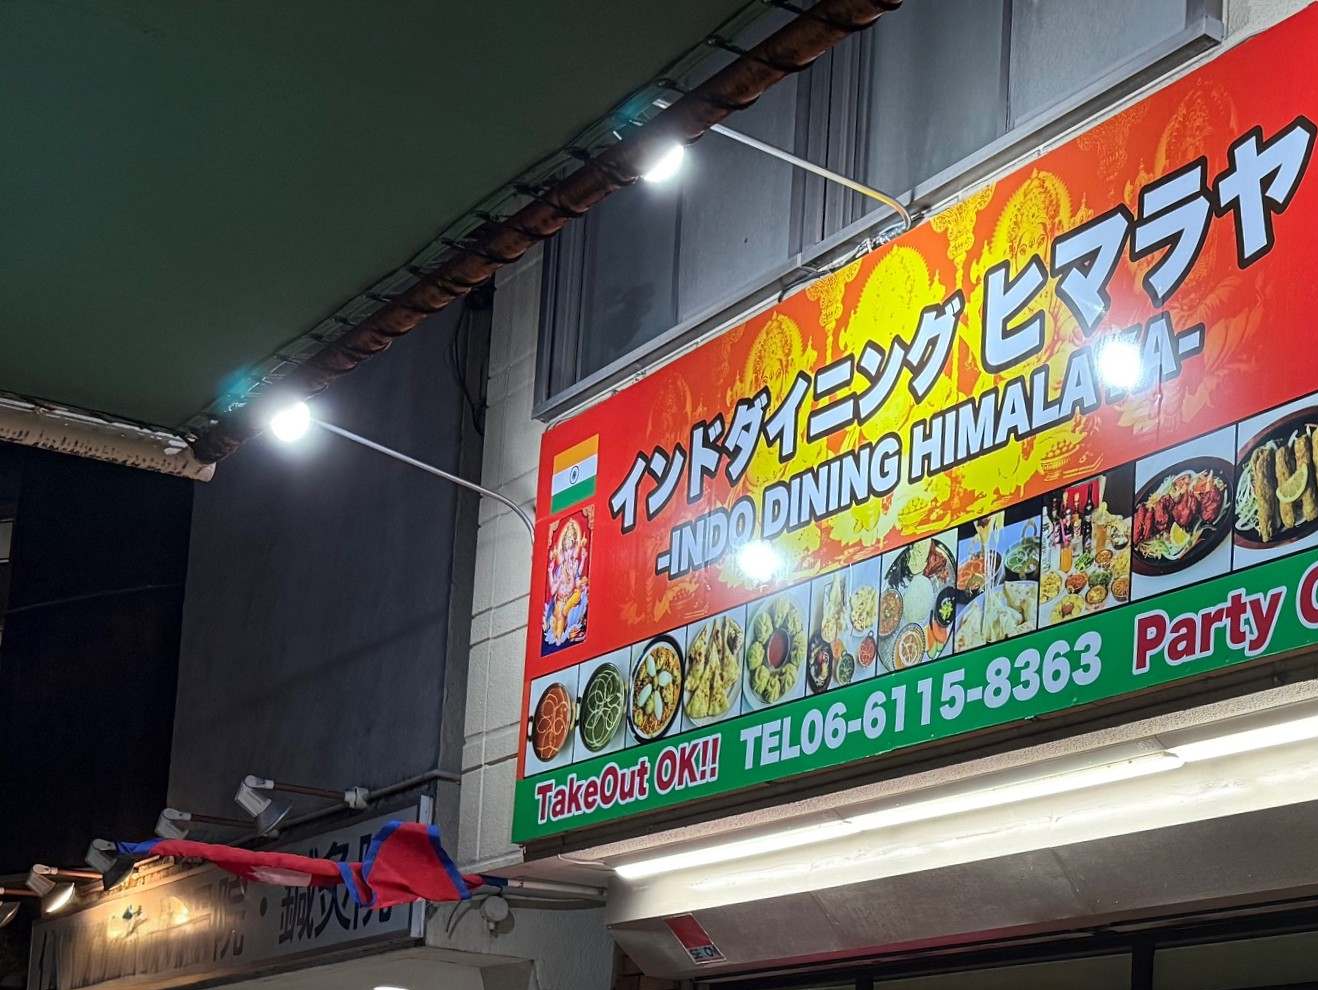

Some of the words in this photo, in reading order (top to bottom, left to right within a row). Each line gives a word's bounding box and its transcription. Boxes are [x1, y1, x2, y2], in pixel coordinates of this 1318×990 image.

[609, 289, 965, 534] インドダイニング
[982, 114, 1318, 373] ヒマラヤ
[760, 432, 902, 540] DINING
[1132, 587, 1287, 675] Party
[740, 631, 1103, 770] TEL06-6115-8363
[535, 758, 648, 824] TakeOut
[655, 733, 722, 794] OK!!
